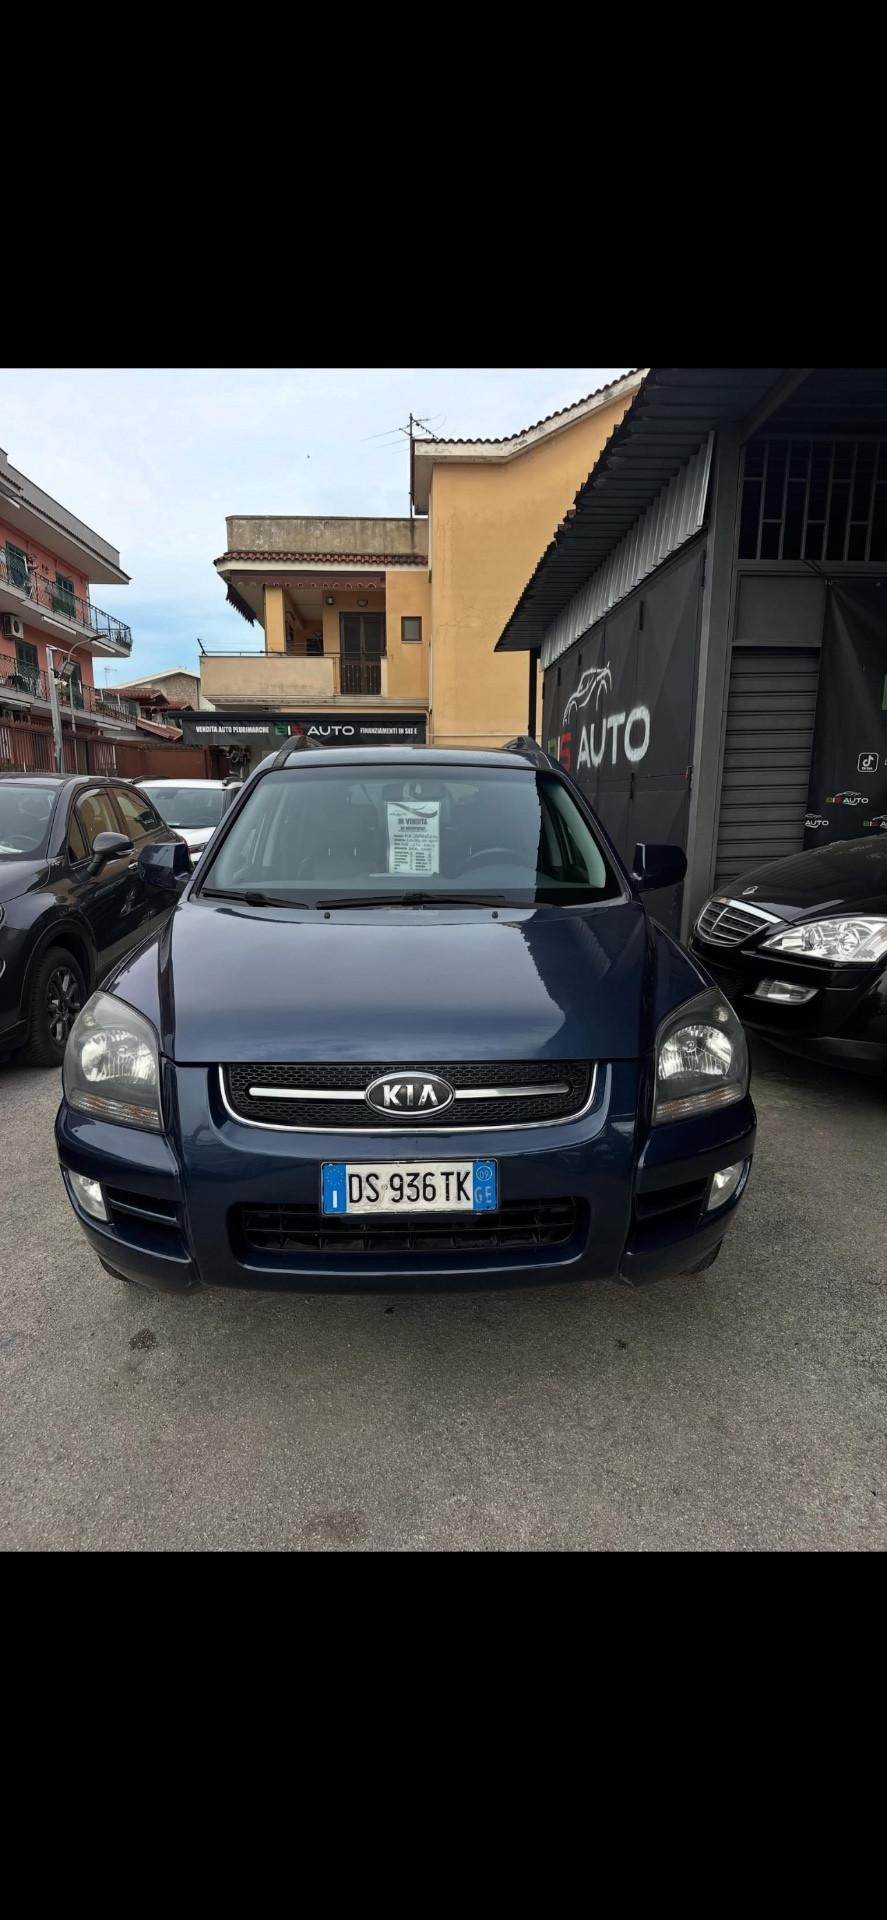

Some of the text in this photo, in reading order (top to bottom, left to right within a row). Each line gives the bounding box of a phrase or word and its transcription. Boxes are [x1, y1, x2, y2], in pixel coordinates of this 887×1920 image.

[307, 726, 355, 736] AUTO
[577, 706, 651, 771] AUTO
[382, 1084, 439, 1106] KIA
[348, 1173, 379, 1203] DS
[389, 1171, 437, 1203] 936
[440, 1171, 471, 1202] TK
[474, 1186, 492, 1204] GE
